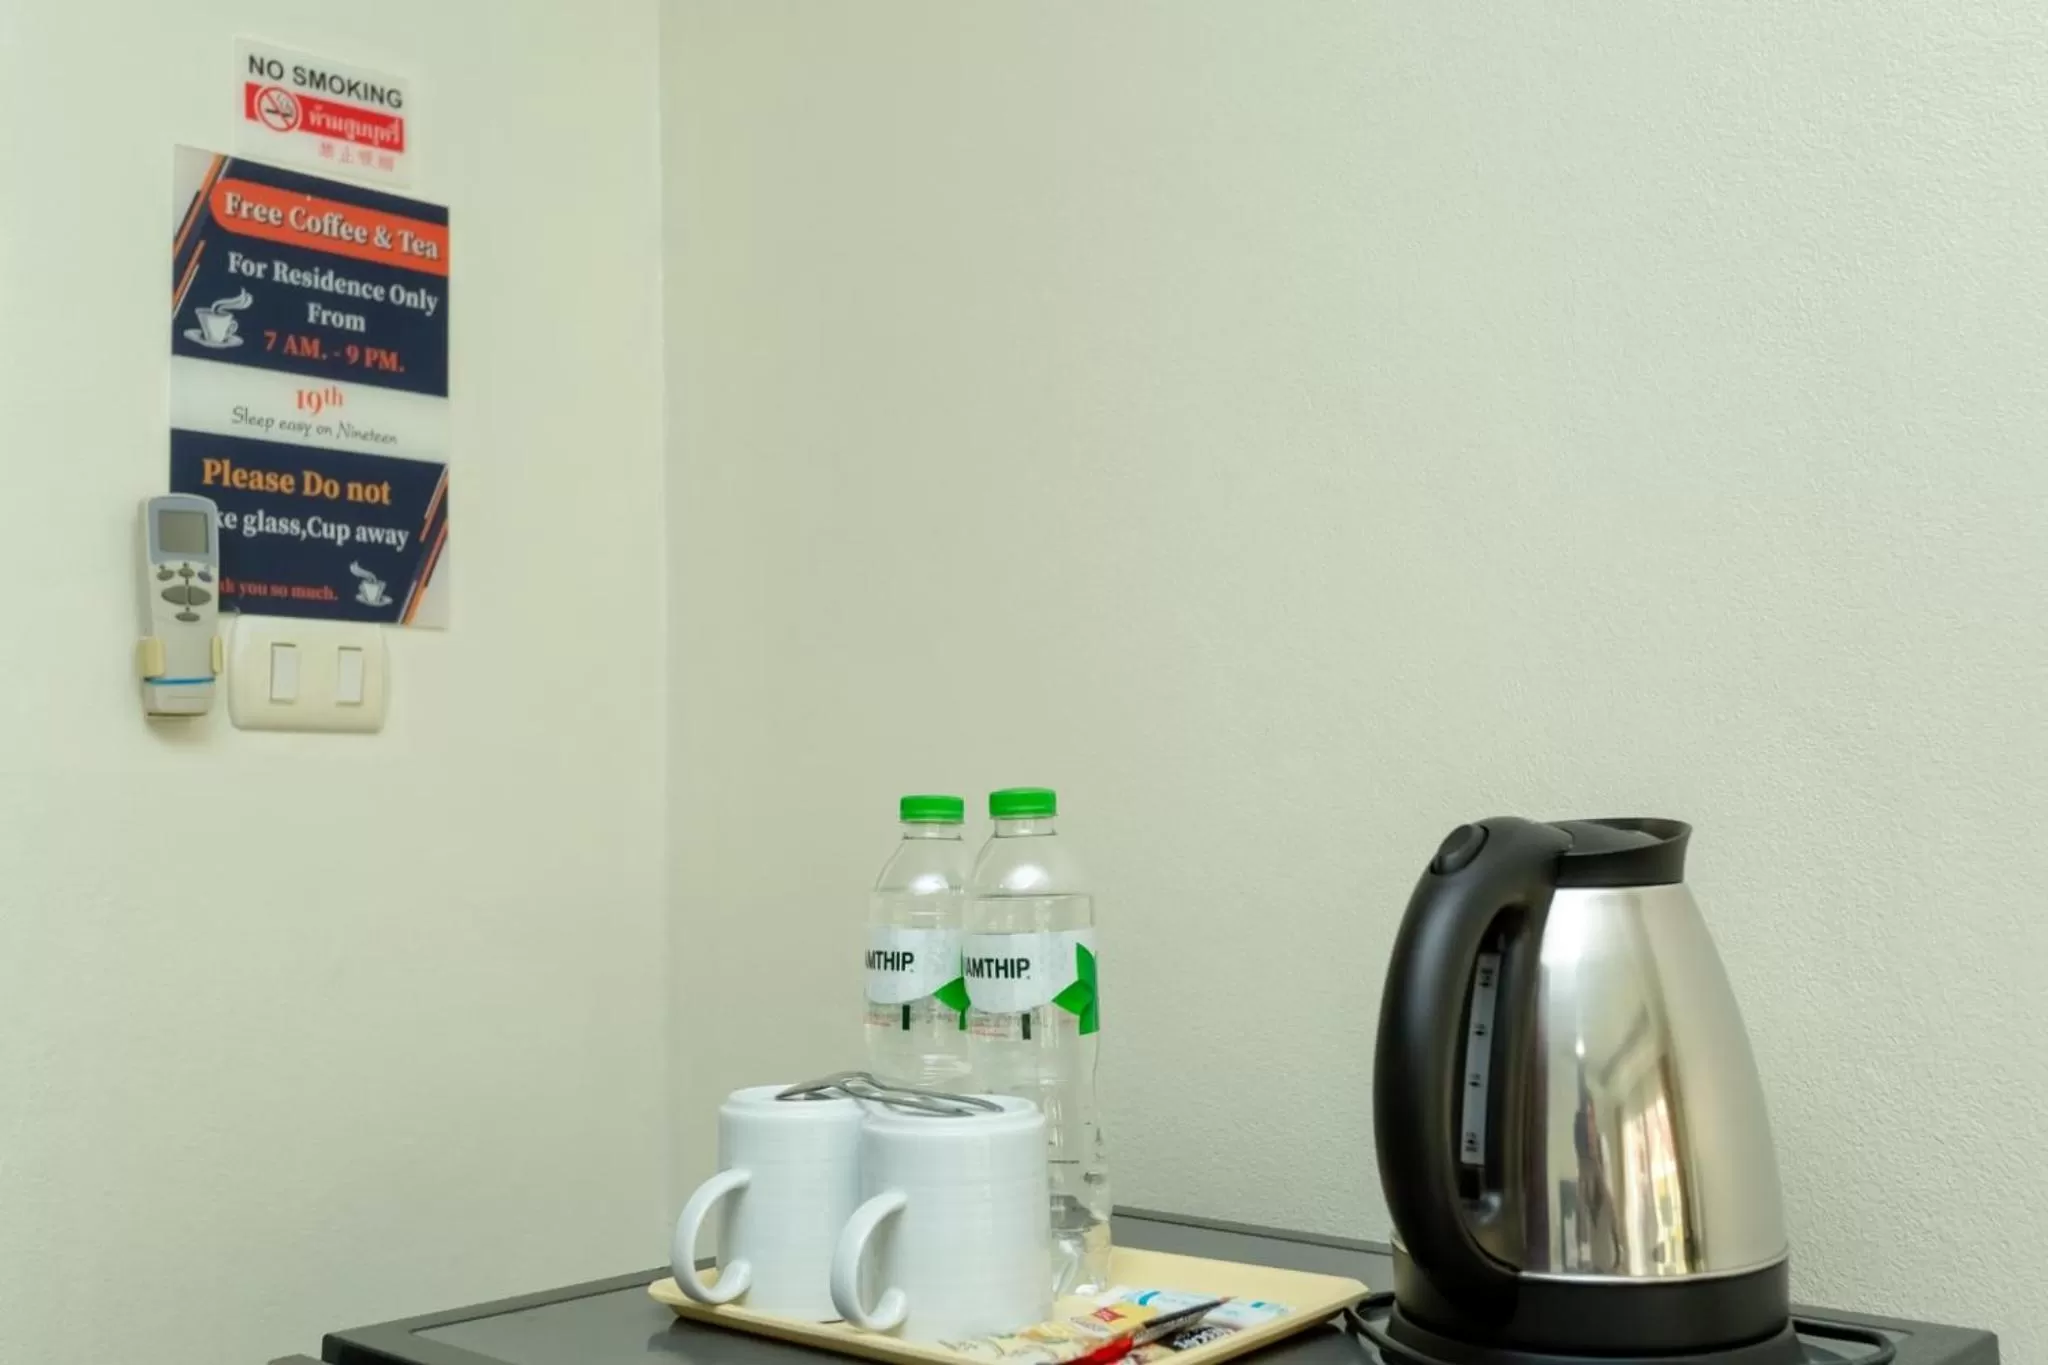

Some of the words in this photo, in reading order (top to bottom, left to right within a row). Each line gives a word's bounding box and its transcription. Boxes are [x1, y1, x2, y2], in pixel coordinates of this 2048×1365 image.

[248, 54, 284, 81] NO
[292, 66, 403, 109] SMOKING
[224, 190, 282, 226] Free
[288, 205, 368, 245] Coffee
[374, 226, 392, 249] &
[397, 230, 439, 261] Tea
[228, 251, 268, 279] For
[272, 260, 385, 303] Residence
[389, 283, 438, 317] Only
[307, 302, 366, 333] From
[263, 330, 277, 351] 7
[283, 334, 328, 361] AM.
[345, 345, 359, 366] 9
[364, 349, 405, 373] PM.
[296, 385, 343, 416] 19th
[232, 404, 275, 432] Sleep
[279, 419, 312, 439] easy
[316, 424, 333, 437] on
[336, 421, 398, 446] Nineteen
[202, 457, 296, 495] Please
[302, 470, 340, 499] Do
[347, 479, 392, 506] not
[217, 510, 238, 530] ke
[243, 508, 350, 545] glass,Cup
[355, 526, 409, 552] away
[238, 582, 268, 602] you
[270, 583, 288, 599] so
